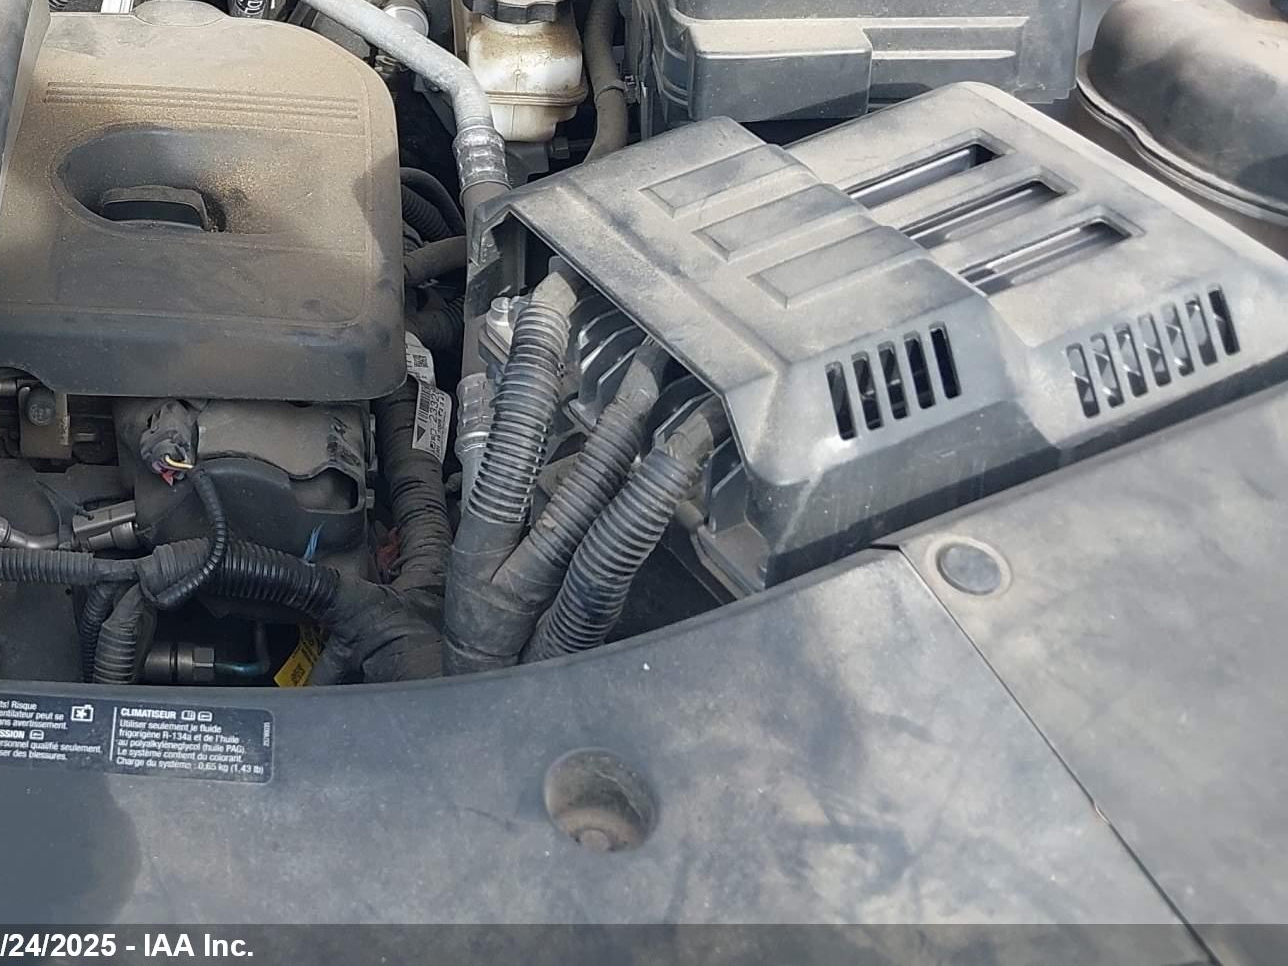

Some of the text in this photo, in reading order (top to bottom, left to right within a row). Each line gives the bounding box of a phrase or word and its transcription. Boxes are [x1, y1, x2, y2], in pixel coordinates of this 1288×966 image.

[11, 700, 37, 711] Risque
[35, 711, 53, 721] peut
[120, 708, 177, 719] CLIMATISEUR
[13, 719, 68, 730] avertissement.
[119, 718, 222, 732] Utiliser seulement le fluide
[163, 732, 191, 740] R-134a
[204, 733, 214, 741] de
[215, 734, 239, 744] l'huile
[60, 743, 102, 754] seulement.
[203, 742, 224, 753] (huile
[226, 744, 247, 754] PAG).
[12, 749, 27, 757] des
[29, 750, 67, 760] blessures.
[164, 750, 195, 760] contient
[197, 752, 208, 760] du
[210, 752, 243, 762] colorant.
[116, 758, 144, 767] Charge
[218, 763, 229, 773] kg
[254, 765, 264, 775] lb)
